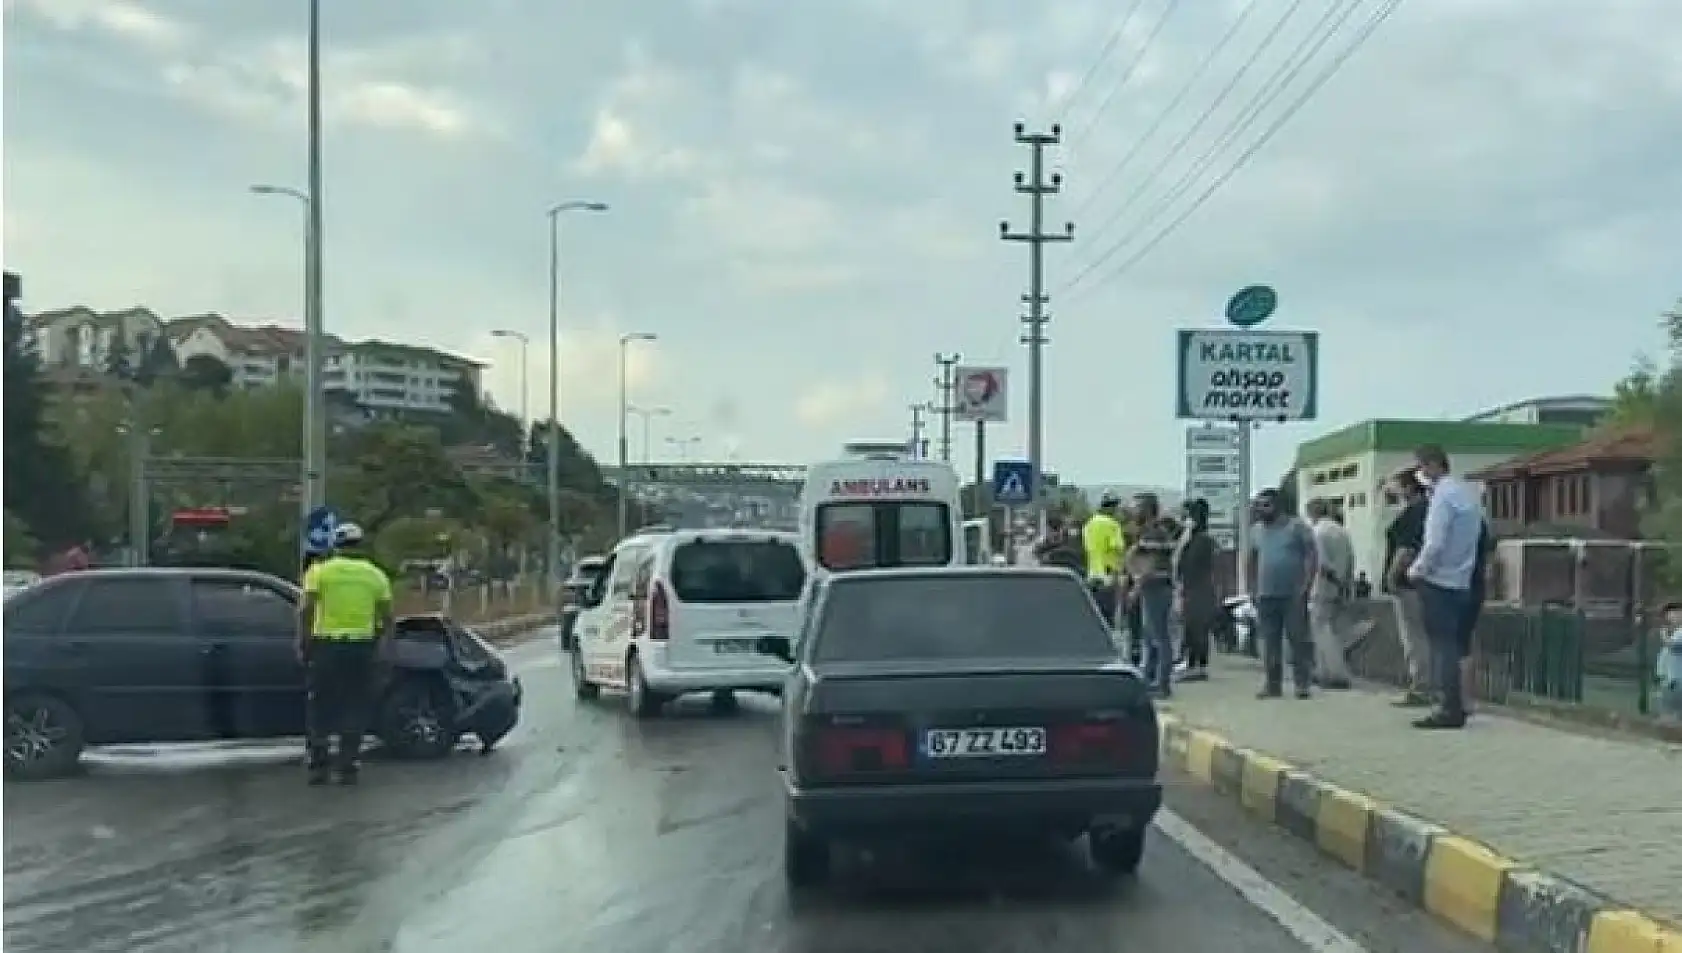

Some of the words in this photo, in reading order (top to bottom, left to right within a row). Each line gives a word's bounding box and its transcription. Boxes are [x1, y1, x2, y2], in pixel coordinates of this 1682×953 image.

[1200, 342, 1294, 362] KARTAL
[1211, 369, 1284, 390] ahşap
[1204, 391, 1290, 408] market
[830, 478, 930, 494] AMBULANS
[931, 730, 959, 753] 67
[966, 730, 995, 752] ZZ
[1000, 728, 1043, 751] 493
